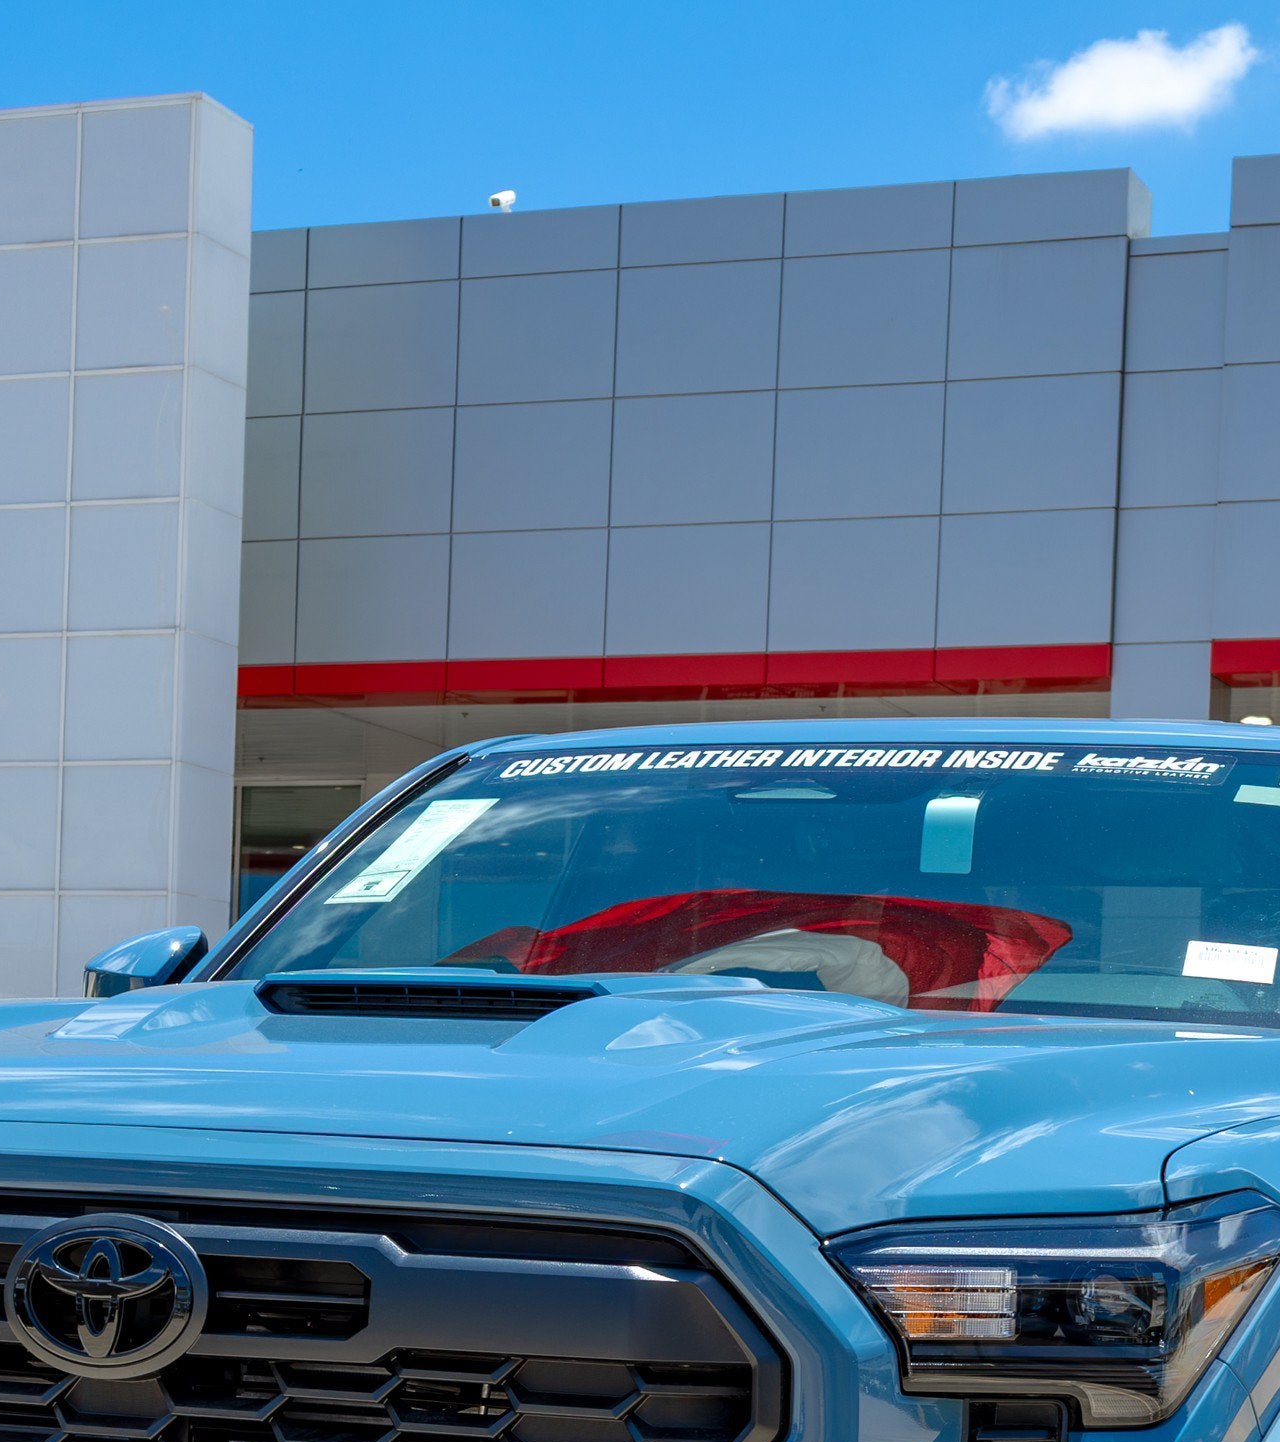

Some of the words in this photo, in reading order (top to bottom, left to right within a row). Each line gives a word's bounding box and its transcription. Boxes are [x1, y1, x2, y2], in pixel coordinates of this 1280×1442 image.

[499, 753, 644, 778] CUSTOM
[637, 750, 784, 770] LEATHER
[781, 749, 942, 767] INTERIOR
[941, 750, 1065, 771] INSIDE
[1074, 753, 1220, 773] katzkin
[1071, 767, 1150, 776] AUTOMOTIVE
[1154, 771, 1211, 780] LEATHER
